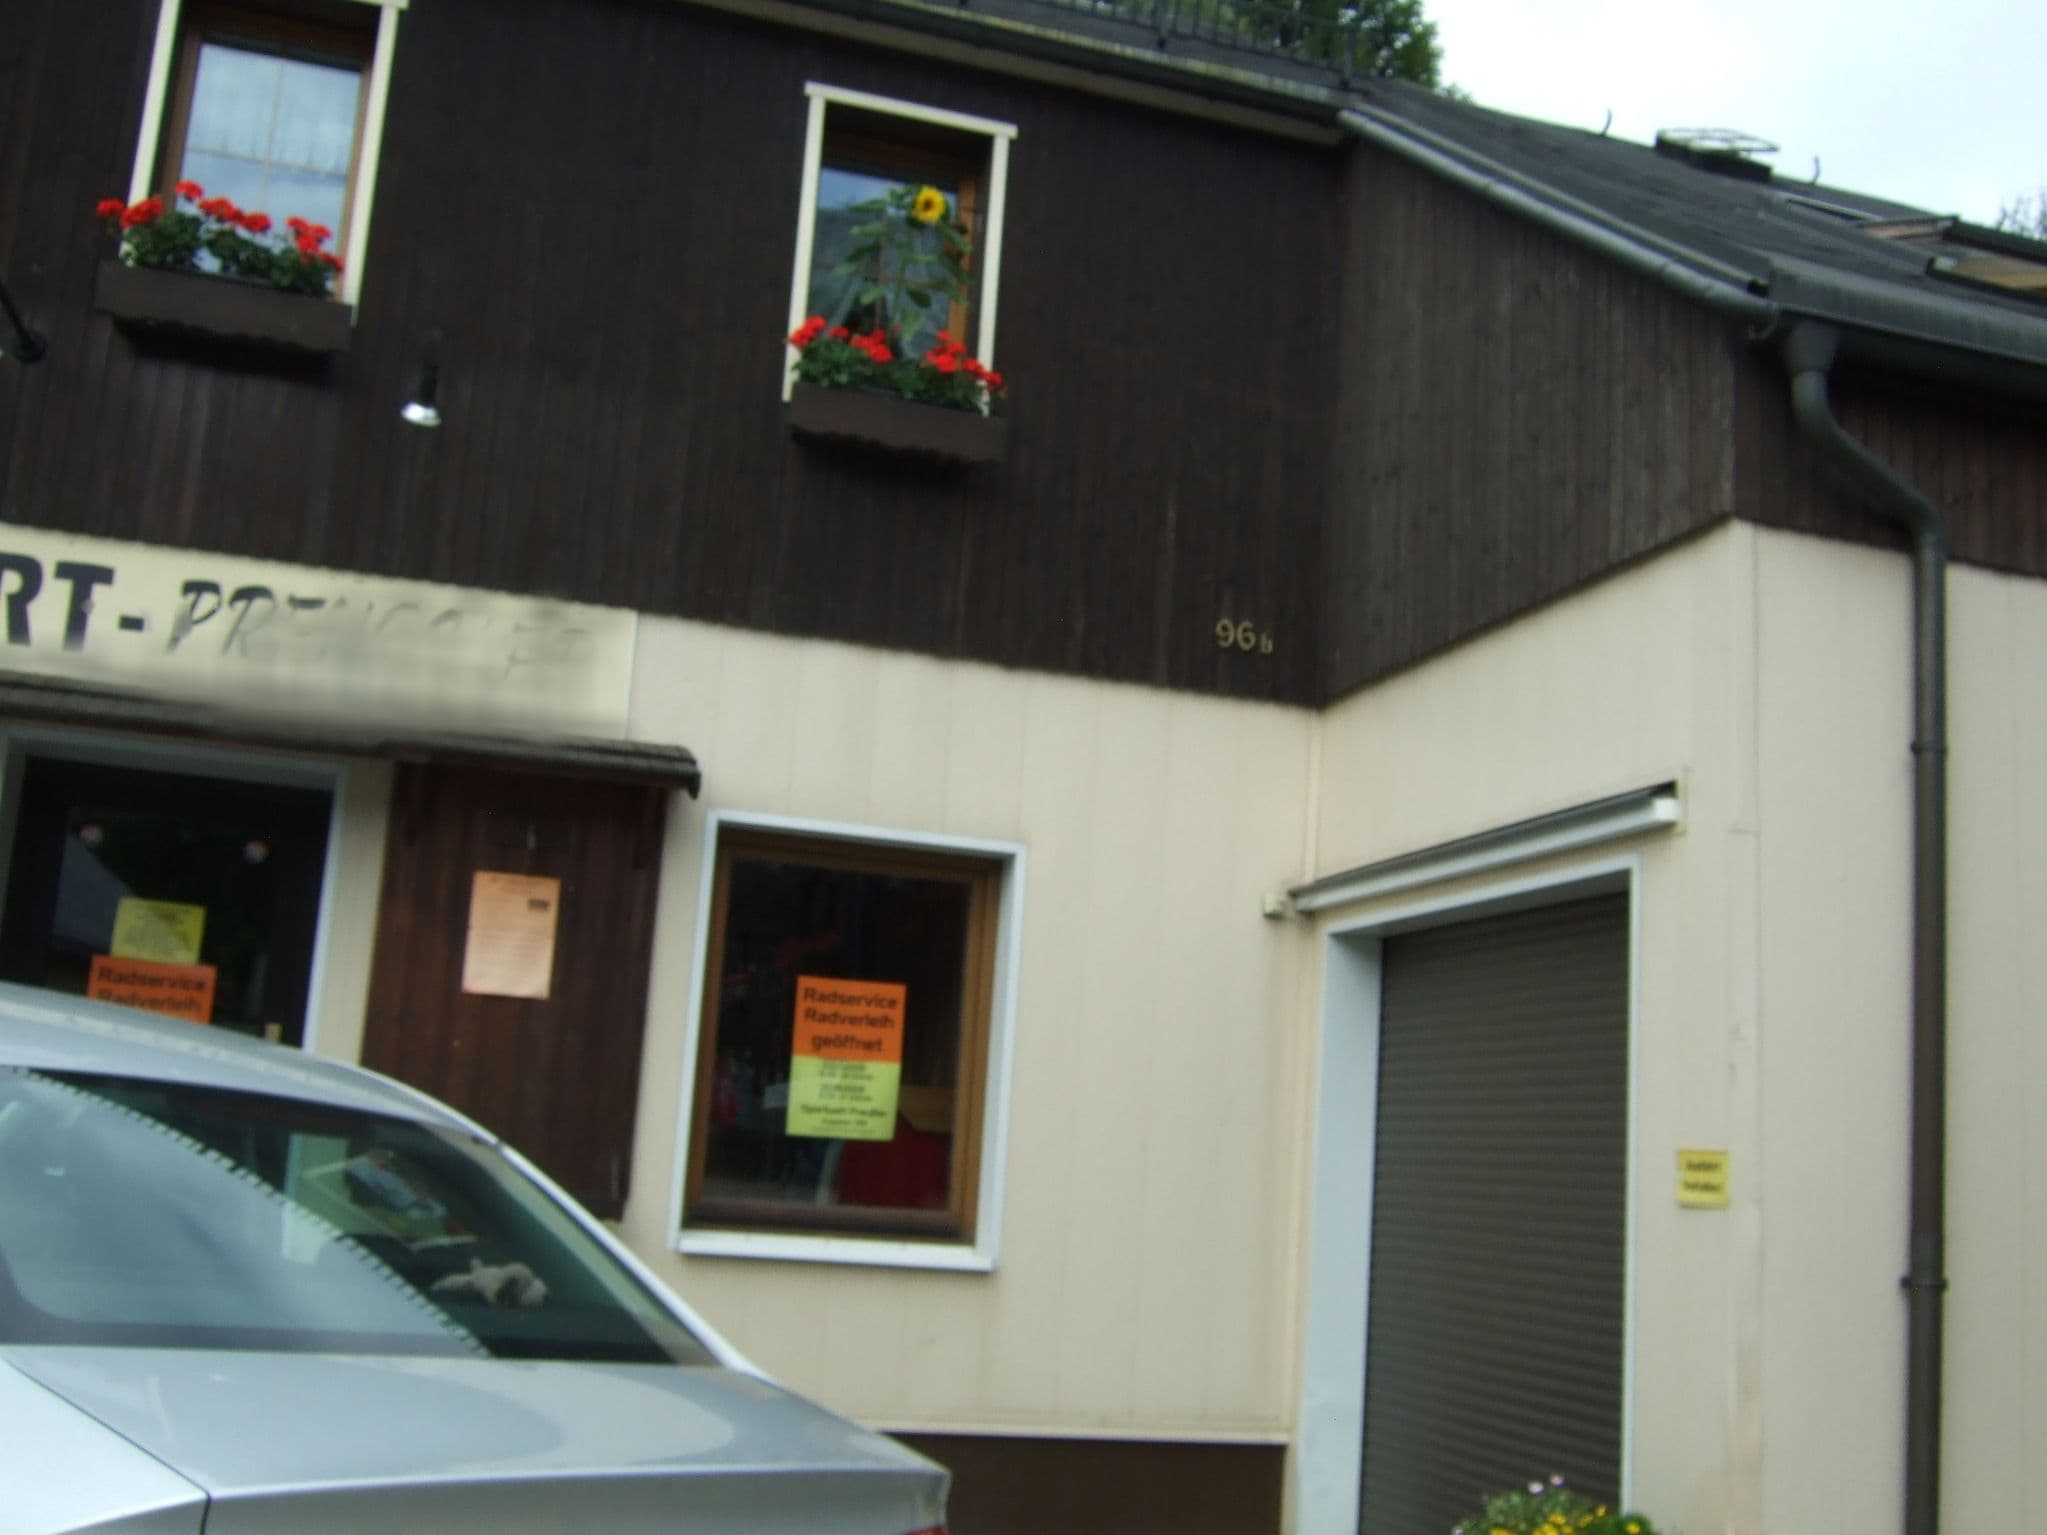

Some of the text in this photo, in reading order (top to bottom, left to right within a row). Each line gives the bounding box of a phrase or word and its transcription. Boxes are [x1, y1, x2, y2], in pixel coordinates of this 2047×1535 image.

[98, 966, 206, 992] Radservice
[804, 987, 897, 1009] Radservice
[804, 1008, 895, 1029] Radverleih
[811, 1034, 883, 1052] geöffnet
